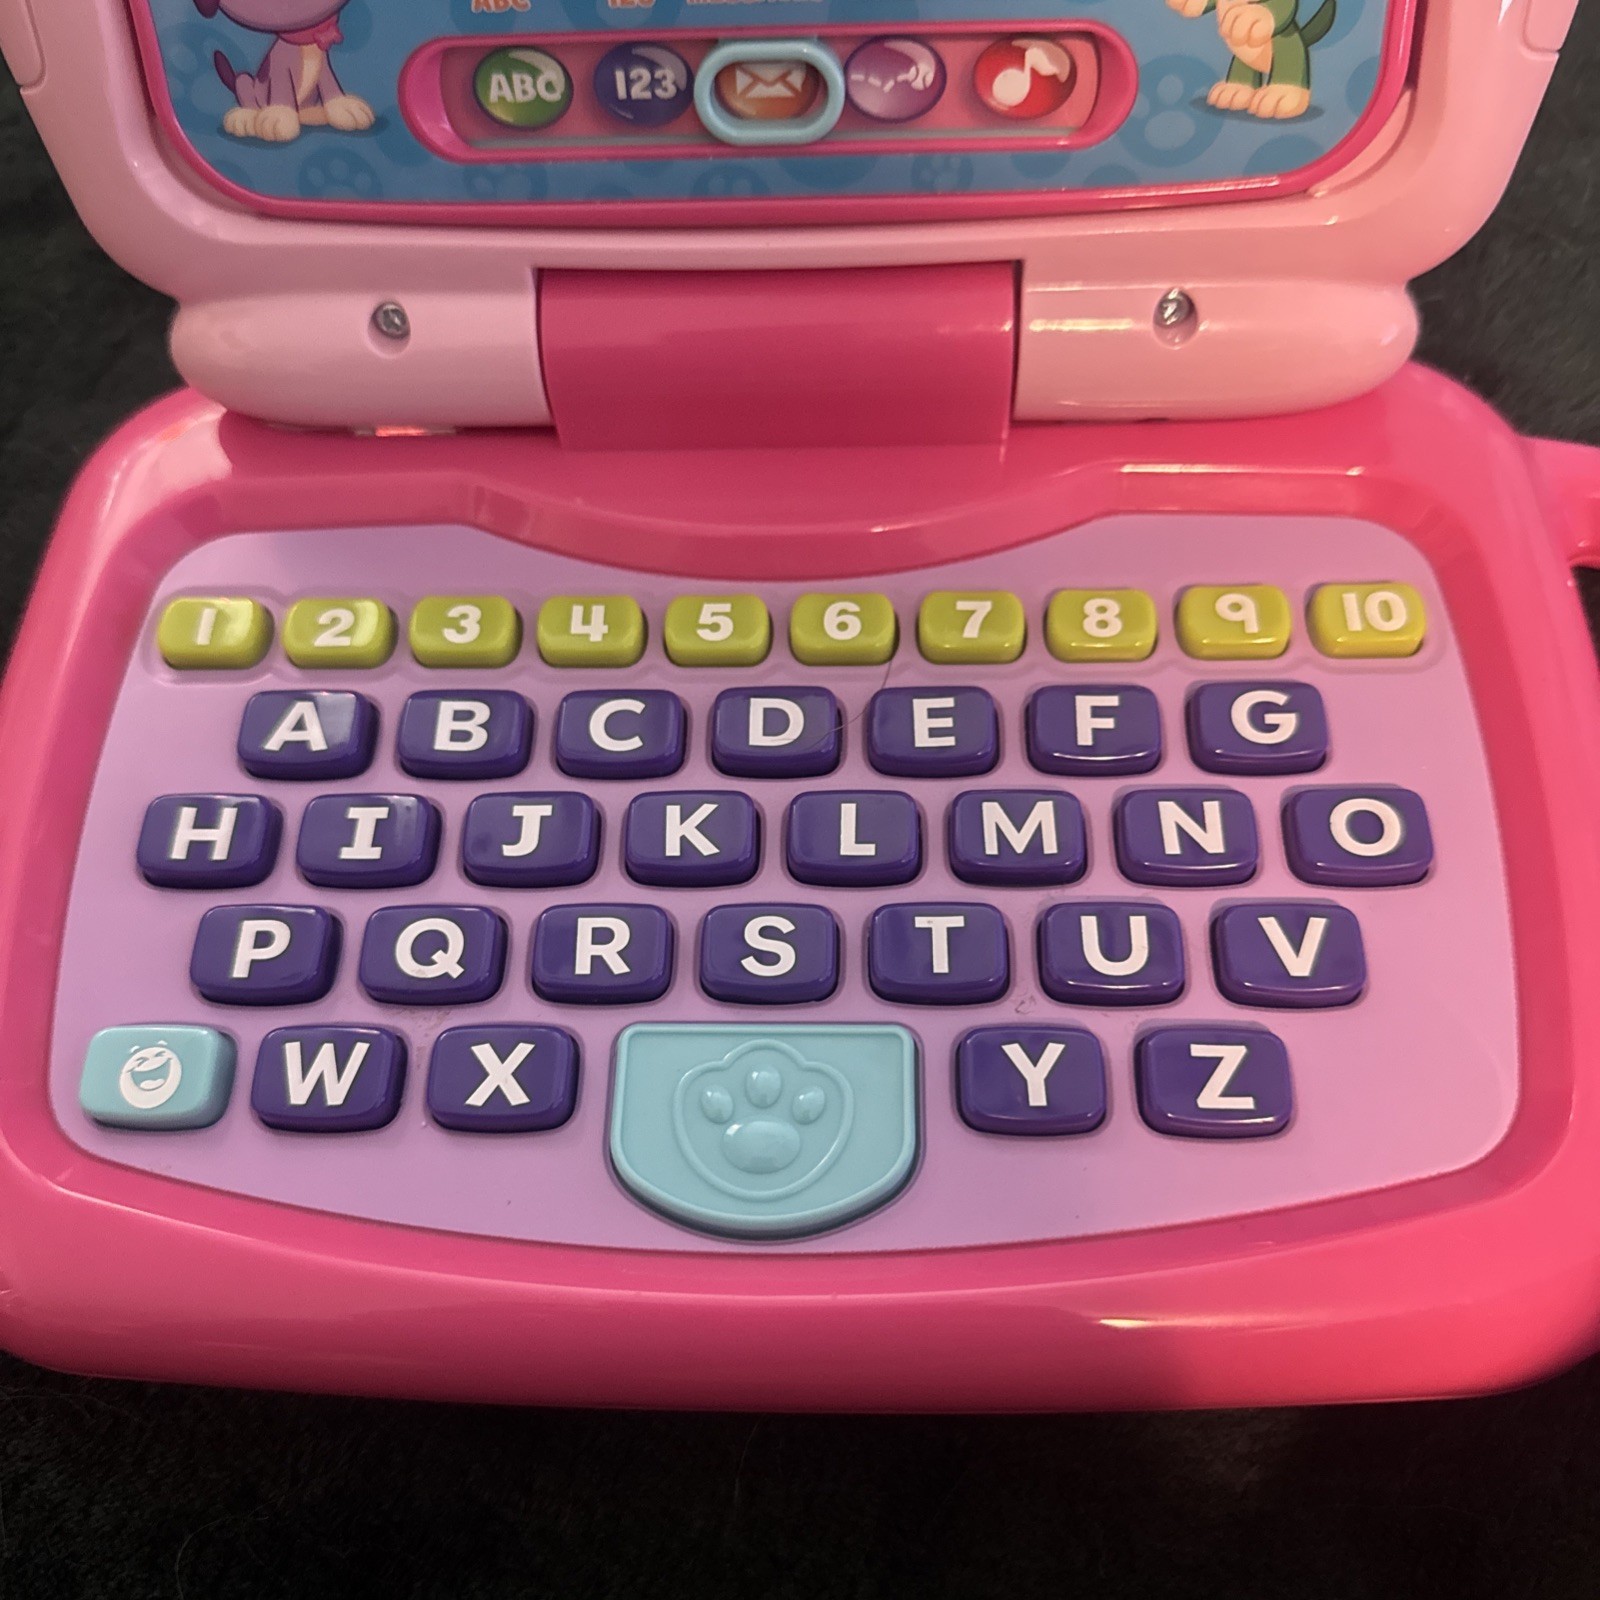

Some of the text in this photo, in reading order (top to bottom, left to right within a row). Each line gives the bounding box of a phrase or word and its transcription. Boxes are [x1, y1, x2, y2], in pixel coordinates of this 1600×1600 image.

[615, 67, 678, 100] 123
[197, 608, 217, 646] 1
[314, 609, 354, 646] 2
[444, 606, 480, 643] 3
[571, 606, 607, 641] 4
[698, 604, 733, 640] 5
[824, 603, 860, 639] 6
[957, 602, 991, 637] 7
[1085, 599, 1121, 636] 8
[1215, 593, 1259, 633] 9
[1345, 592, 1406, 630] 10
[263, 701, 327, 751] A
[434, 701, 490, 751] B
[589, 699, 645, 751] C
[749, 698, 804, 746] D
[913, 698, 955, 747] E
[1076, 696, 1119, 745] F
[1231, 690, 1297, 744] G
[170, 807, 237, 860] H
[339, 807, 389, 859] I
[502, 805, 552, 856] J
[666, 804, 719, 856] K
[840, 803, 875, 855] L
[982, 801, 1057, 854] M
[1158, 801, 1225, 854] N
[1330, 798, 1402, 856] O
[232, 920, 290, 977] P
[395, 918, 464, 978] Q
[575, 917, 630, 974] R
[741, 916, 795, 976] S
[915, 916, 964, 973] T
[1081, 916, 1148, 975] U
[1258, 917, 1327, 976] V
[285, 1042, 370, 1105] W
[465, 1043, 535, 1106] X
[1002, 1043, 1065, 1106] Y
[1191, 1044, 1254, 1109] Z
